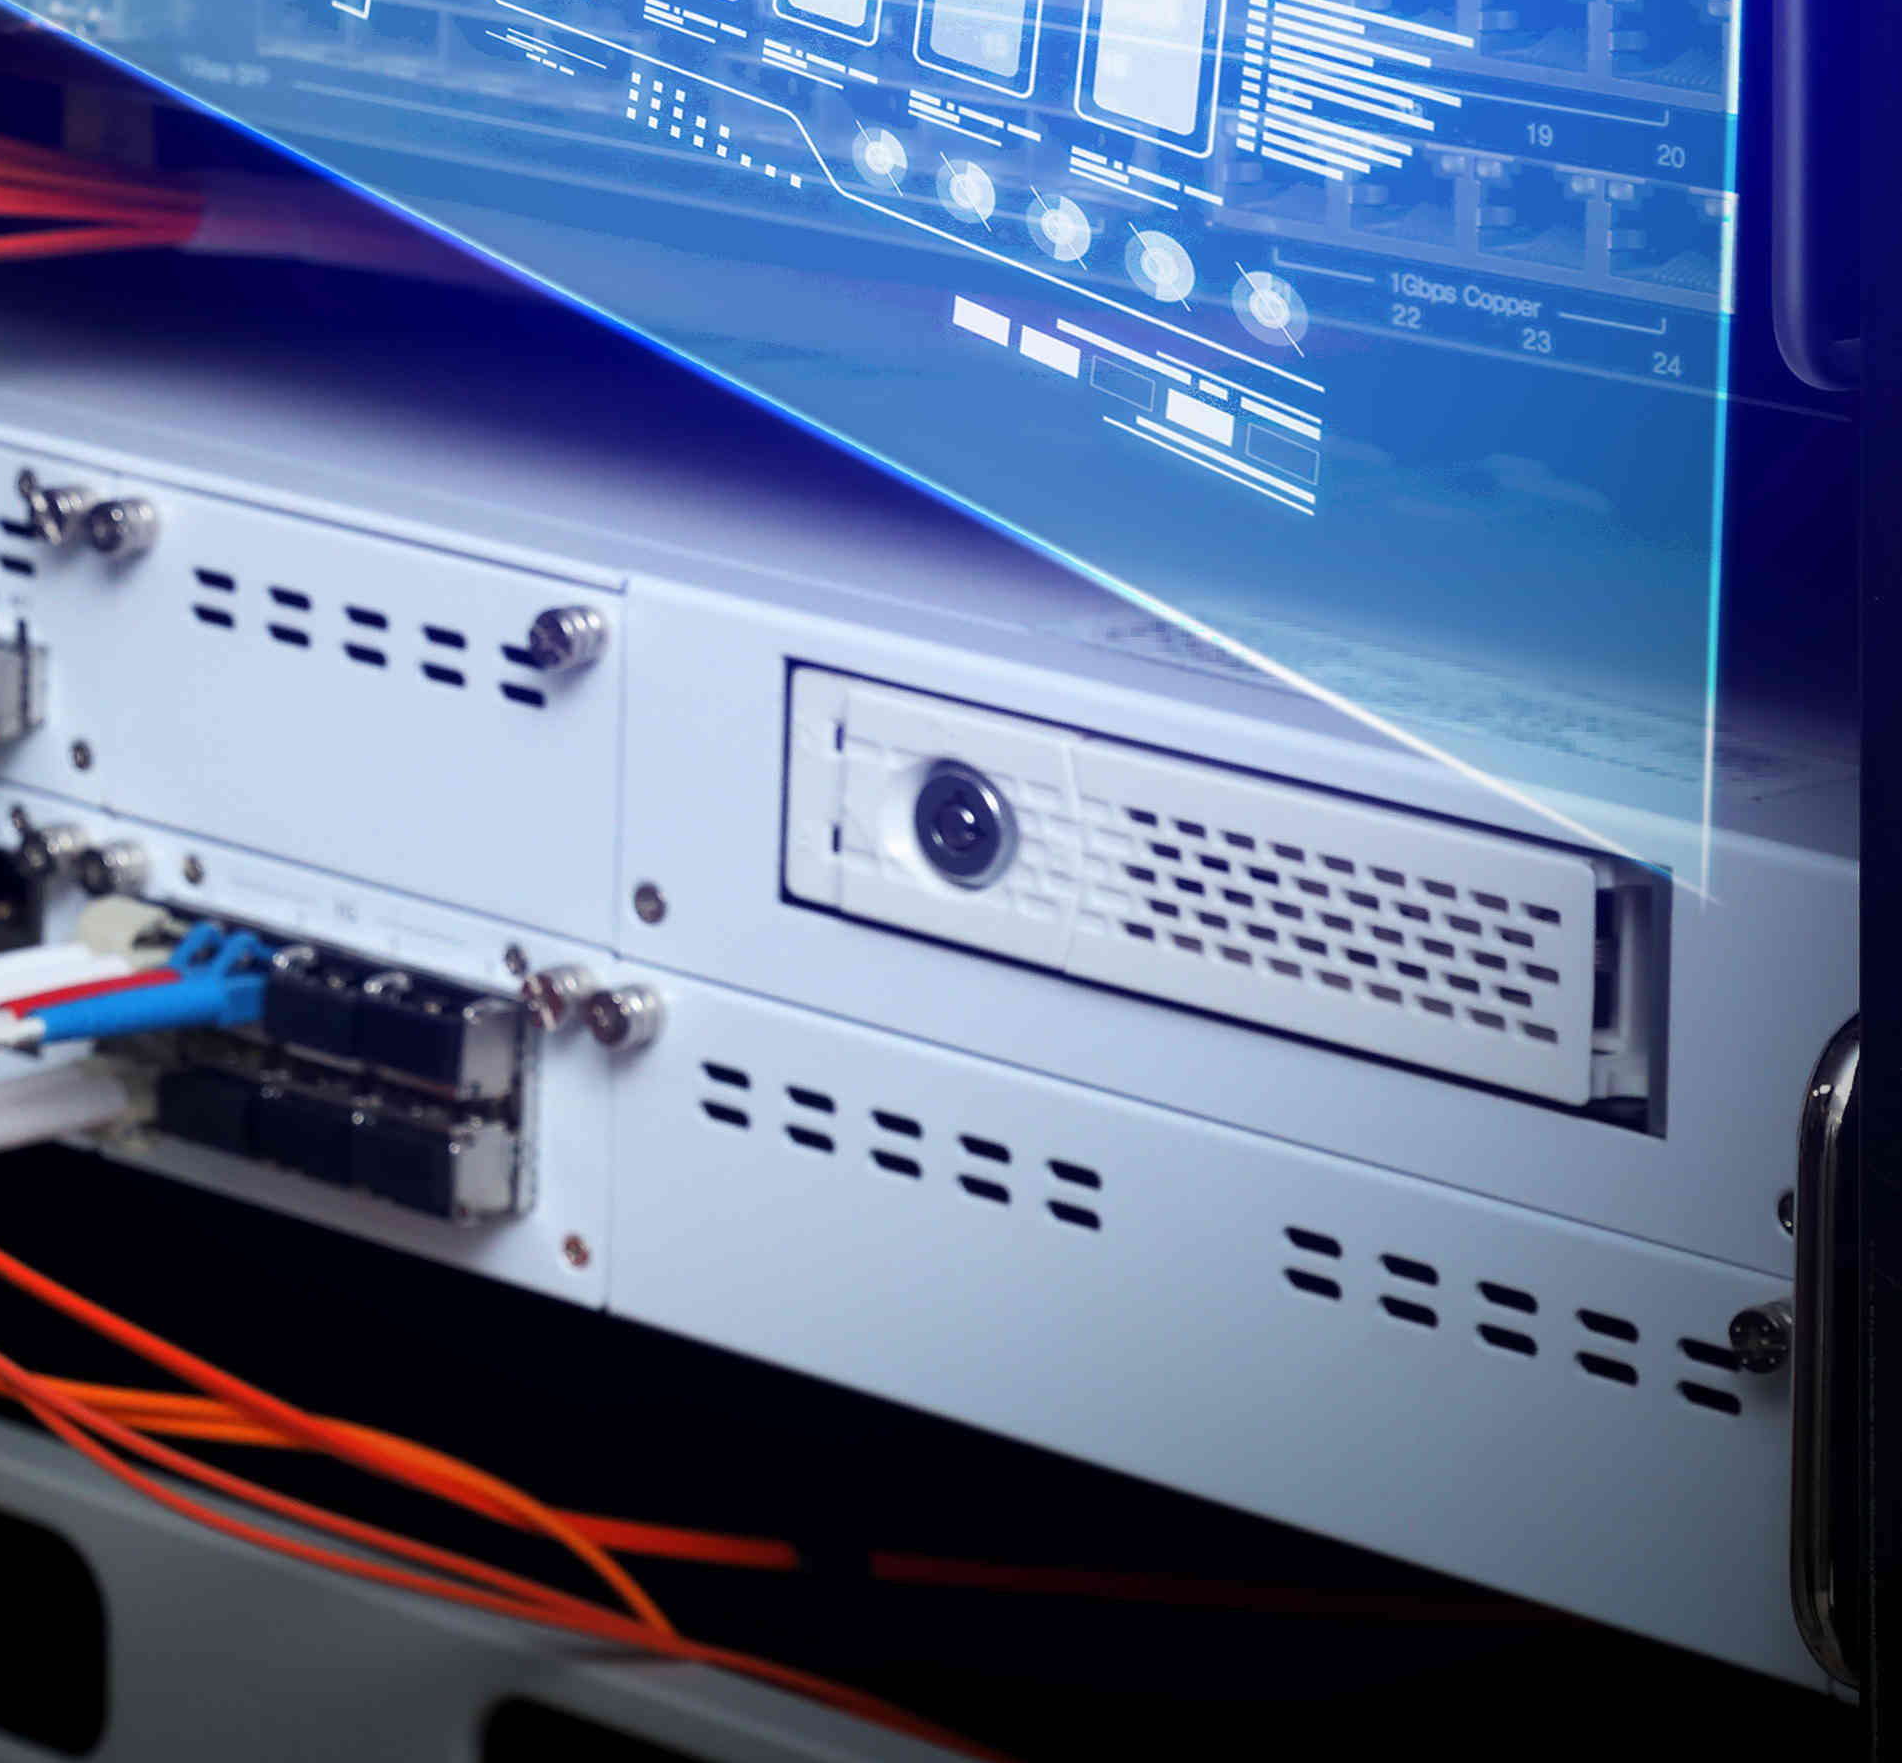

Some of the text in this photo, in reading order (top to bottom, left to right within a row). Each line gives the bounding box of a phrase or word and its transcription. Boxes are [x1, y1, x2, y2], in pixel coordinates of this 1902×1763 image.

[1526, 123, 1553, 147] 19
[1656, 144, 1686, 169] 20
[1389, 271, 1542, 319] 1Gbps Copper
[1391, 303, 1422, 329] 22
[1522, 327, 1552, 354] 23
[1652, 351, 1682, 377] 24
